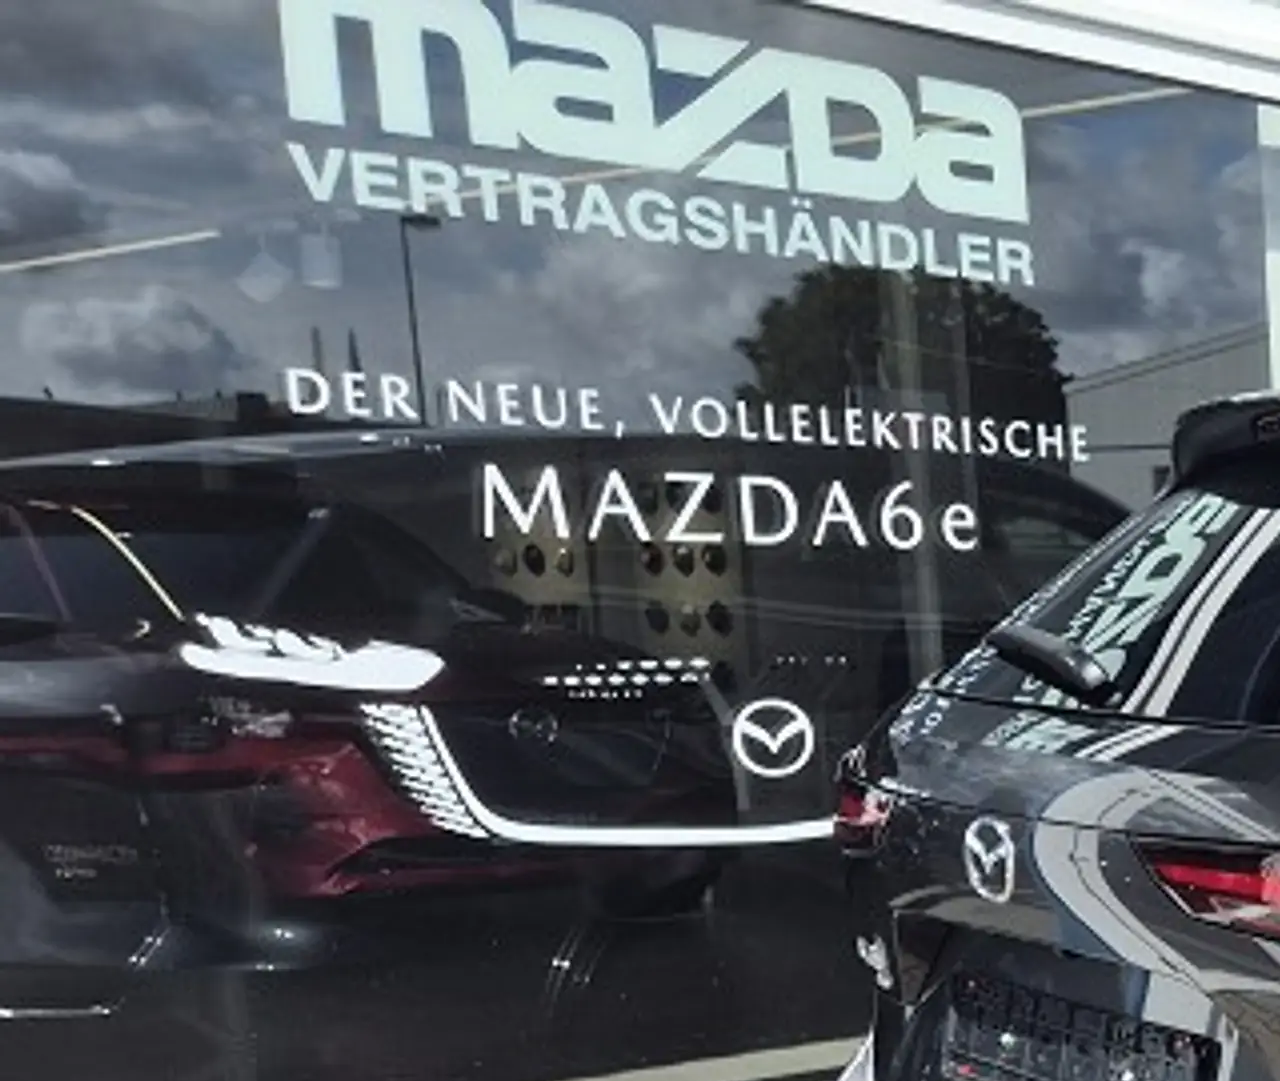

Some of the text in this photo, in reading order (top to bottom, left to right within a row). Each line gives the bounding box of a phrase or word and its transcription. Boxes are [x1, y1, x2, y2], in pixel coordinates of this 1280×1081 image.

[286, 141, 1035, 286] VERTRAGSHÄNDLER
[284, 367, 1091, 462] DER NEUE, VOLLELEKTRISCHE
[482, 462, 978, 551] MAZDA6e
